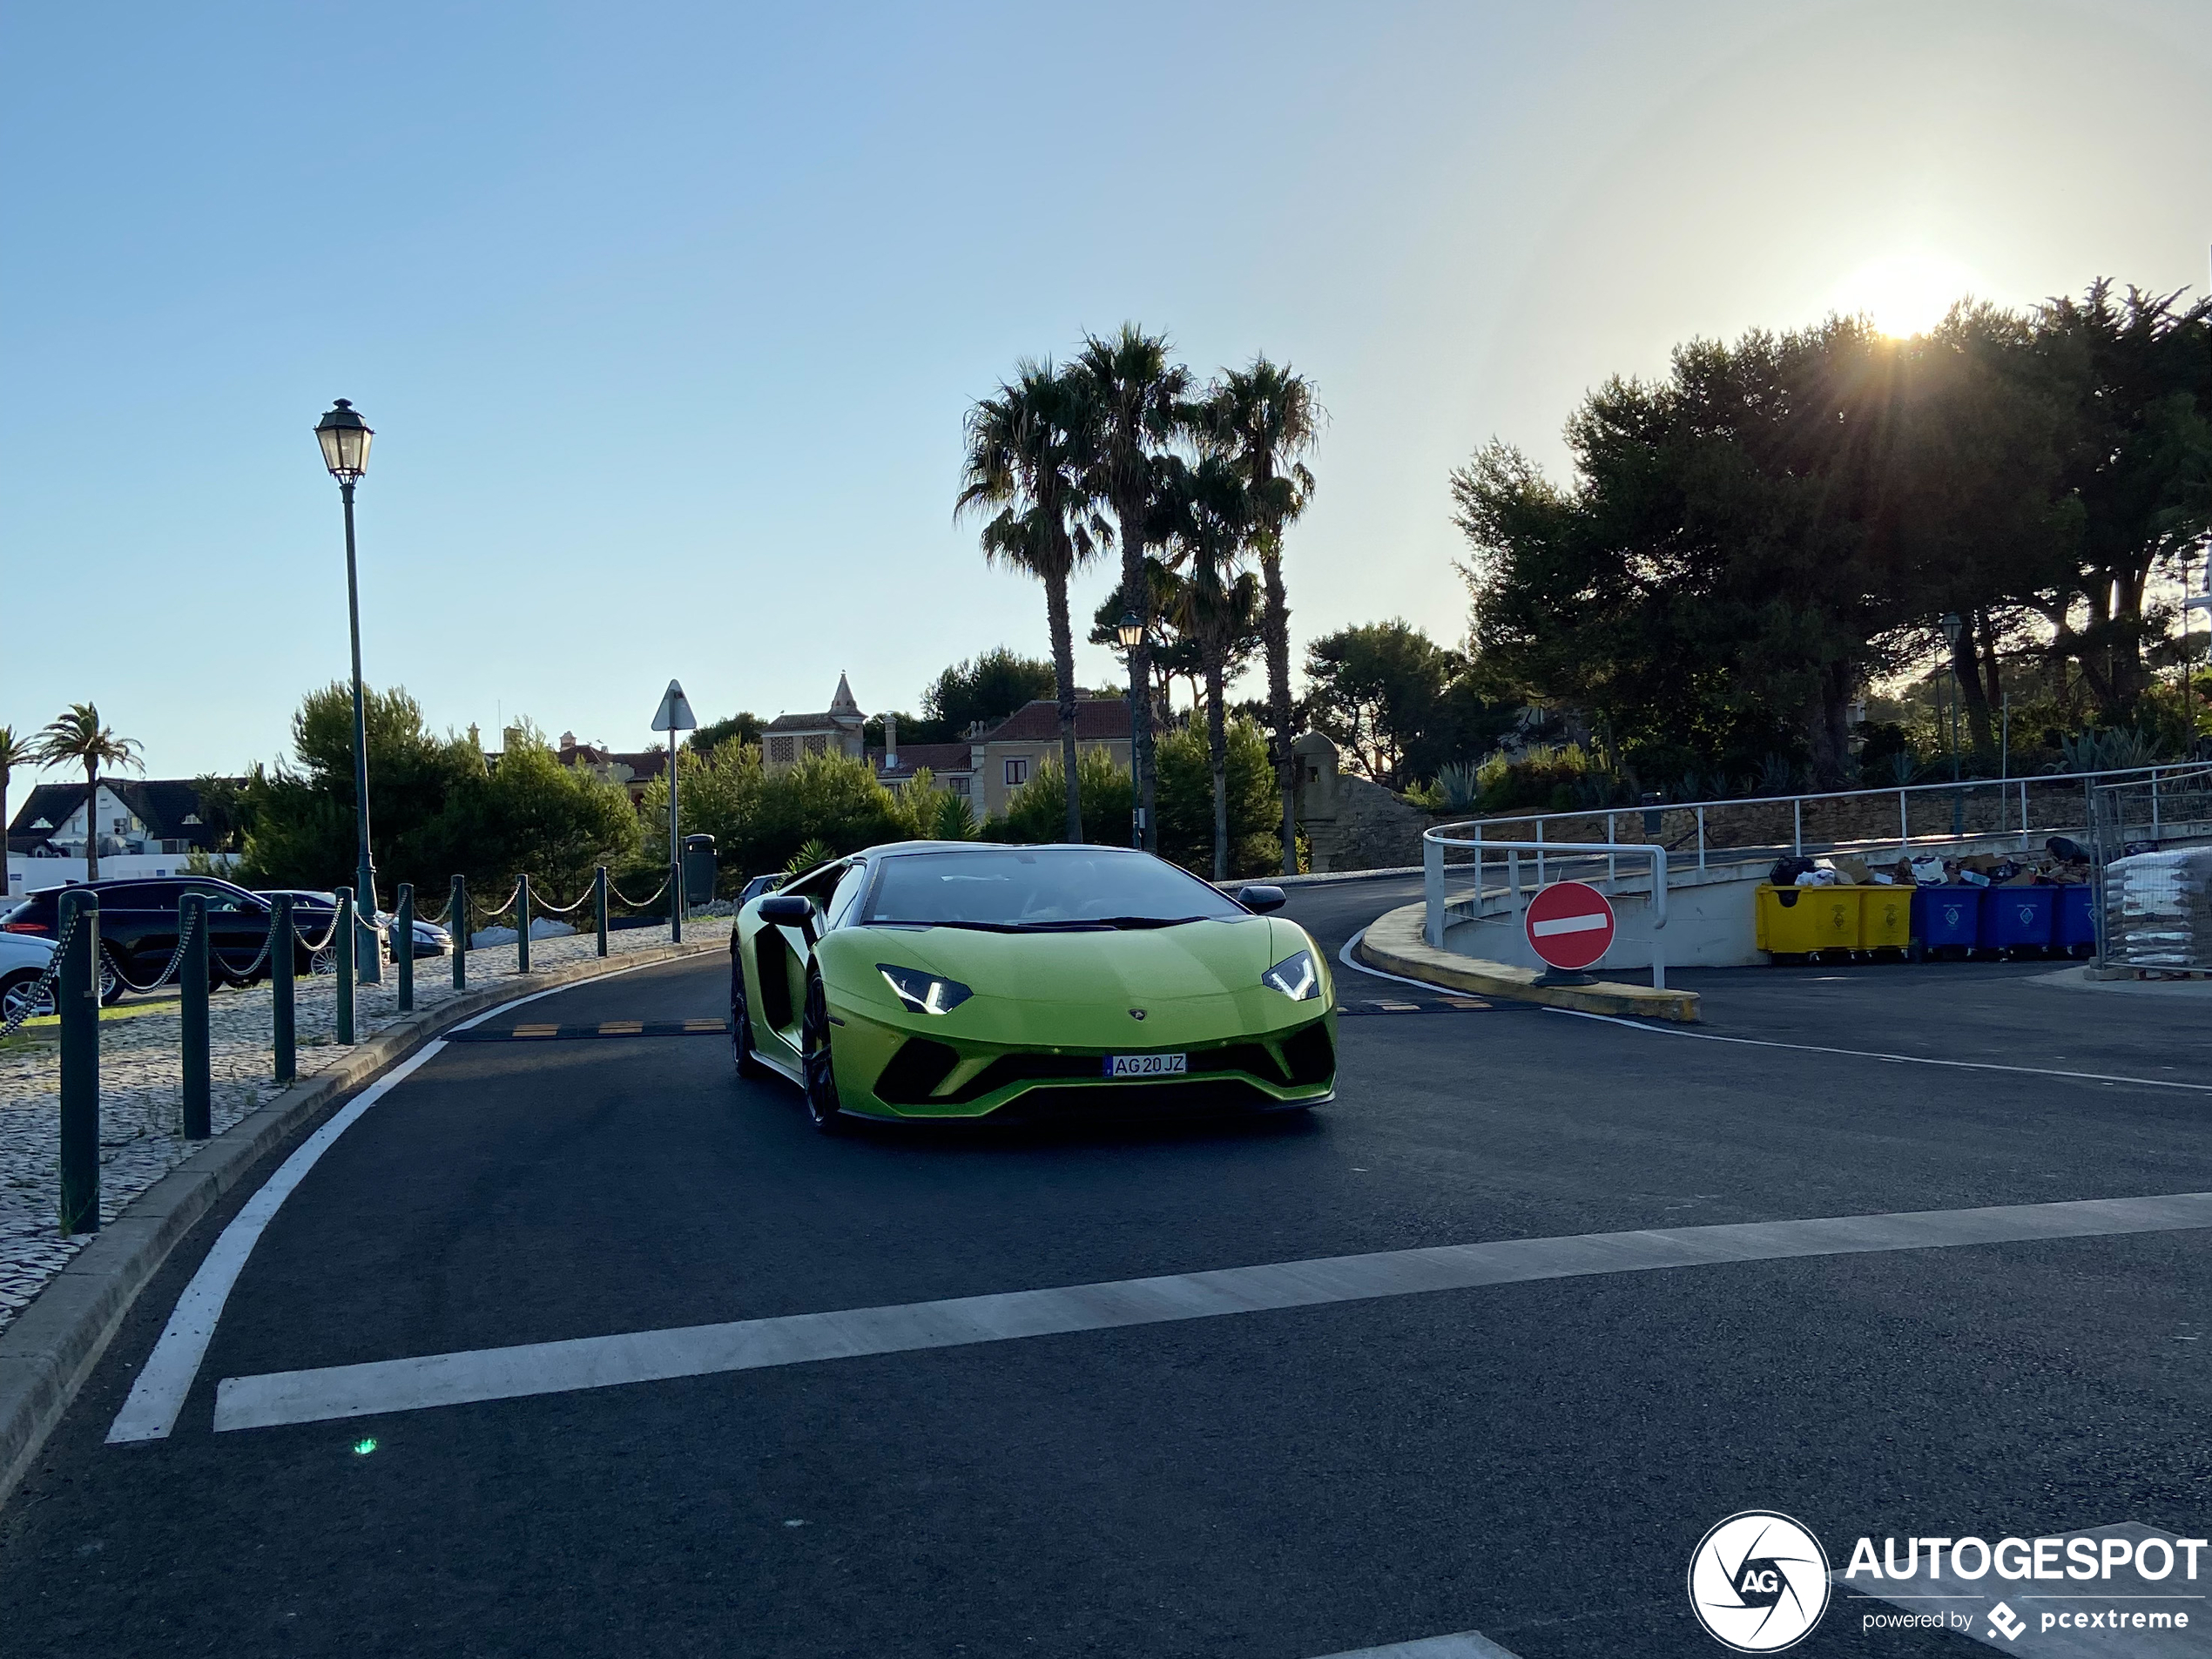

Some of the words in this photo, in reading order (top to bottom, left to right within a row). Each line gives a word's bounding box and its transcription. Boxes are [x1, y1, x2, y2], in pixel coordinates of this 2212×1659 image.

[1115, 1058, 1140, 1074] AG
[1143, 1057, 1162, 1073] 20
[1164, 1055, 1184, 1071] JZ
